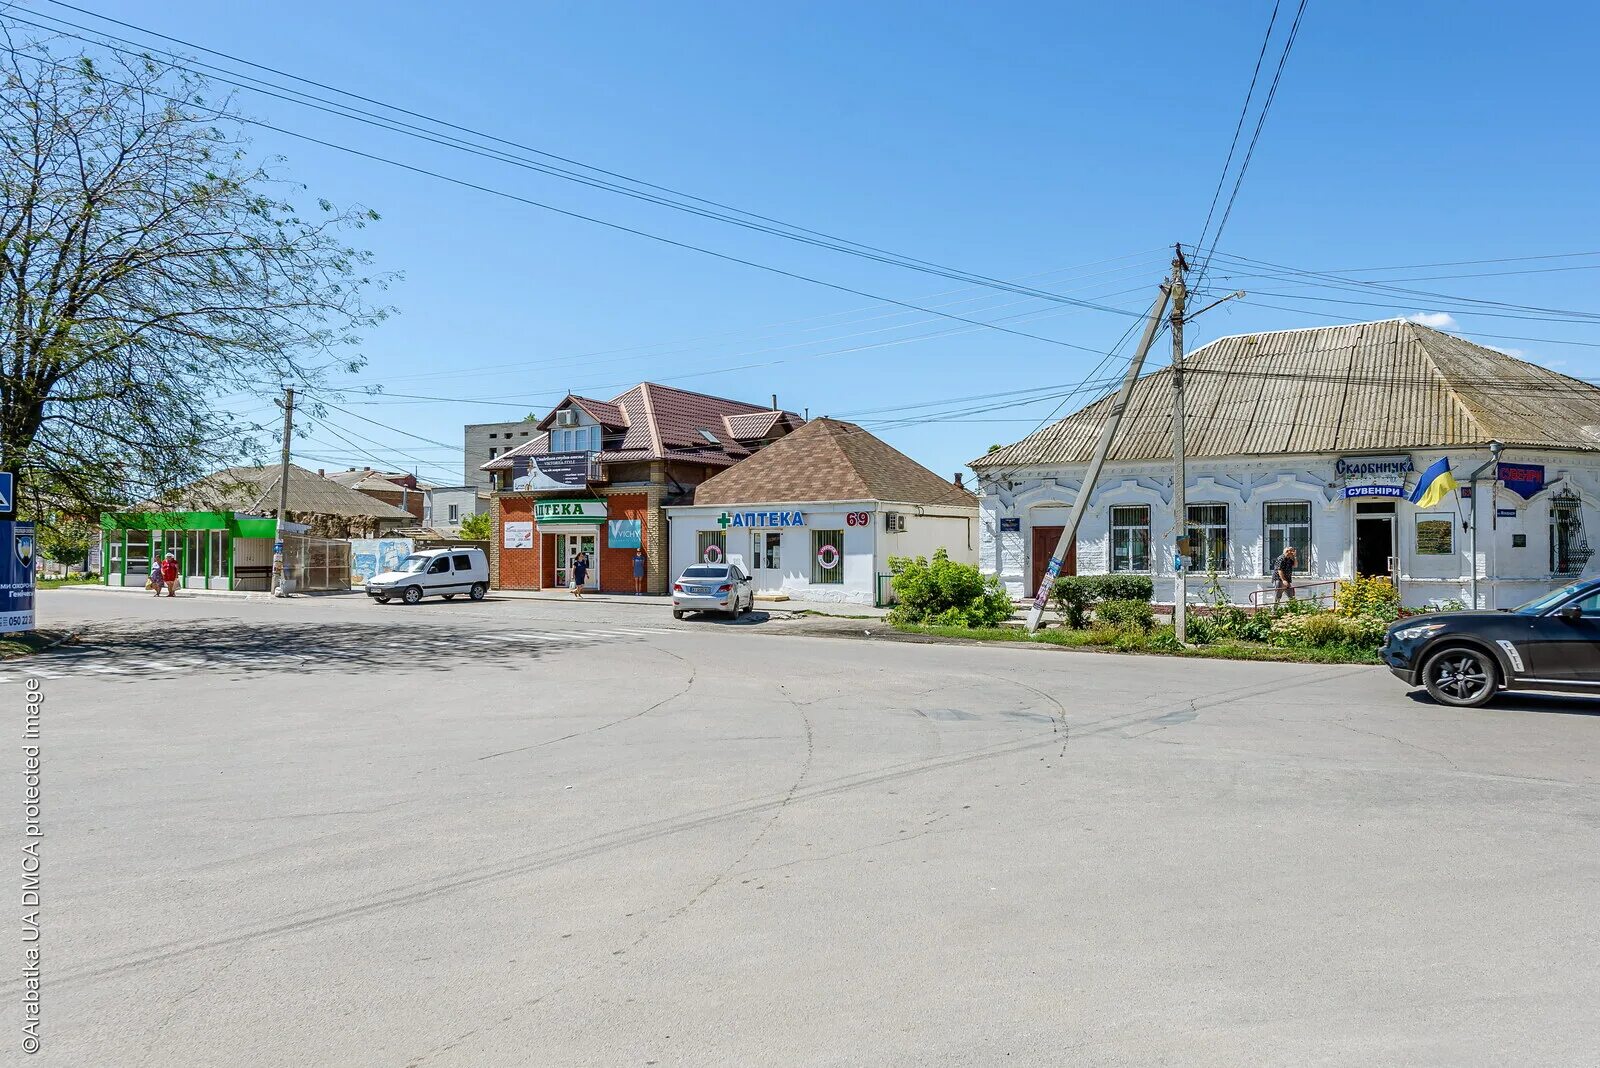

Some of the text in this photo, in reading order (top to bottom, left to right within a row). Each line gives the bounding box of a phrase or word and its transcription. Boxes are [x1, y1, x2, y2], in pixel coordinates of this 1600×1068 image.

[1336, 459, 1415, 478] Скарбничка
[1348, 487, 1400, 496] СУВЕНІРИ
[732, 511, 804, 527] АПТЕКА
[846, 511, 870, 528] 69
[618, 530, 641, 538] VICHY
[9, 616, 21, 626] 050
